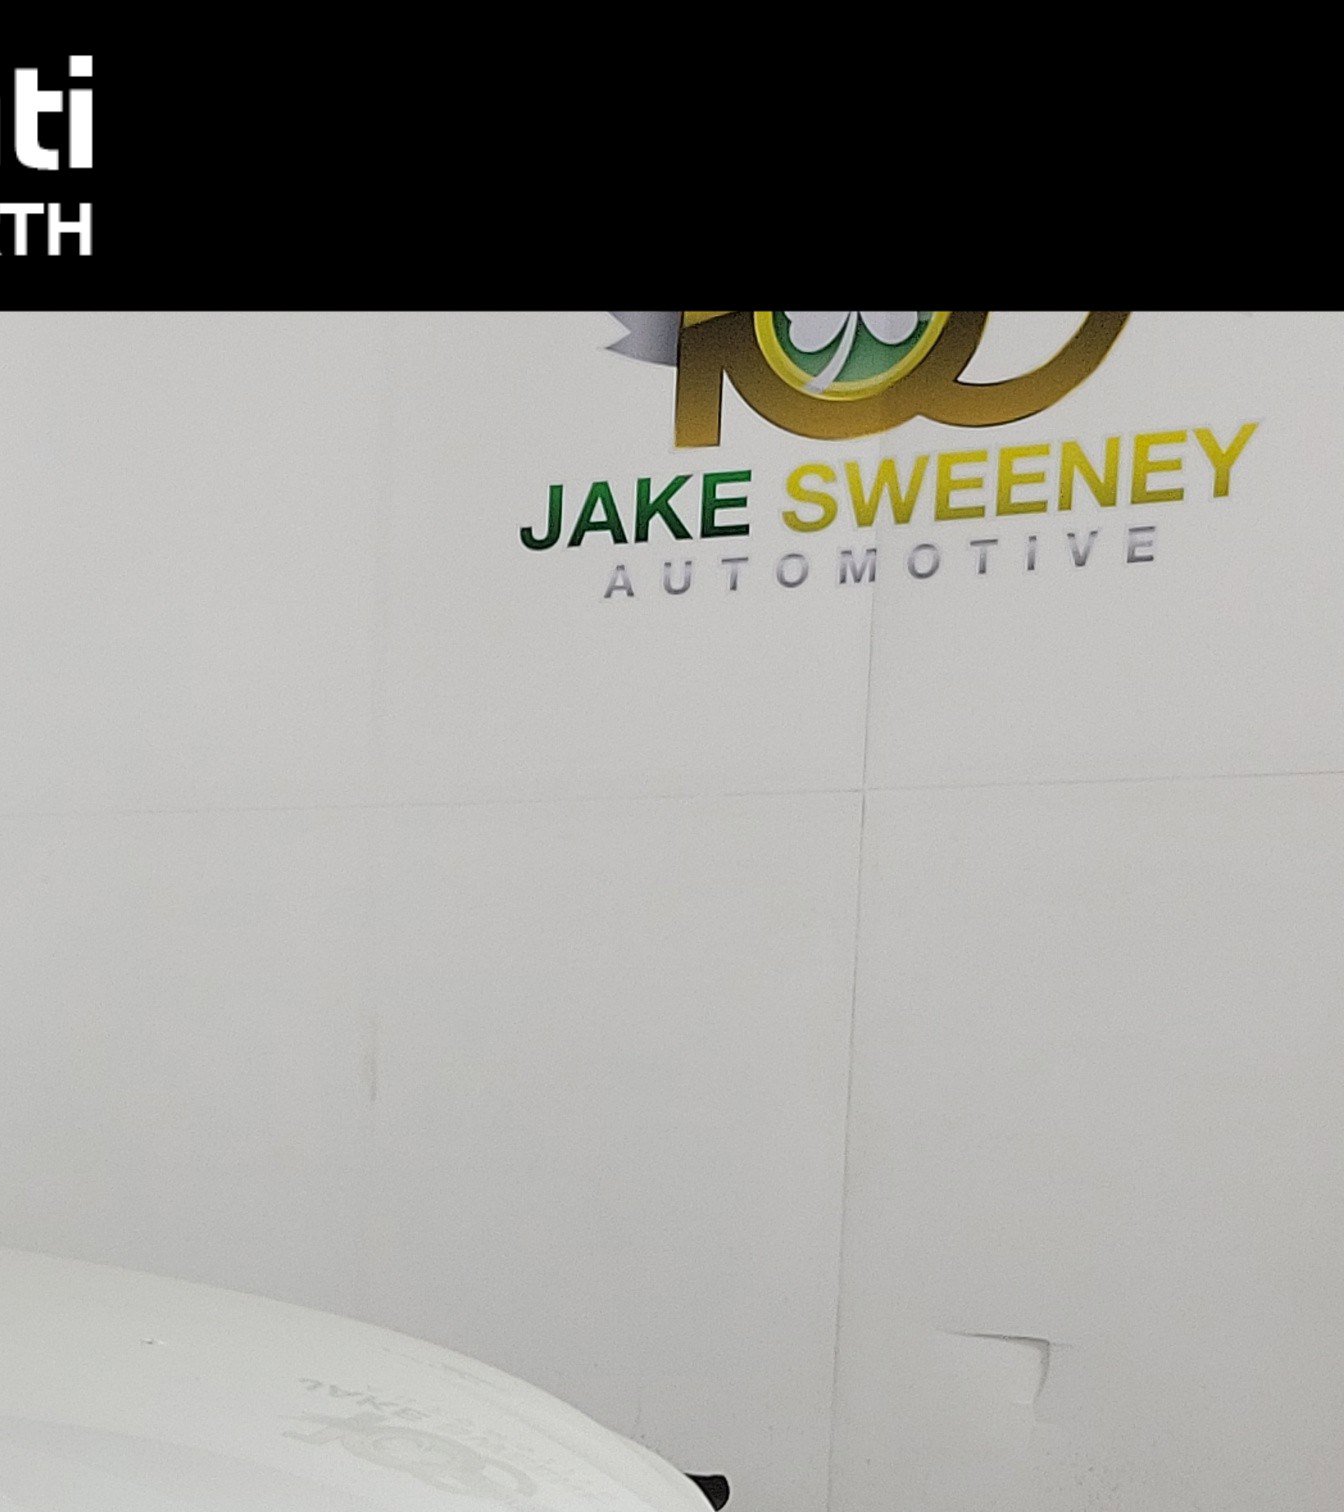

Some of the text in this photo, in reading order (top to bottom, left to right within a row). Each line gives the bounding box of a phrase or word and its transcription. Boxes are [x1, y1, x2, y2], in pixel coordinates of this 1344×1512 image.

[519, 422, 1259, 551] JAKE SWEENEY
[603, 525, 1158, 600] AUTOMOTIVE
